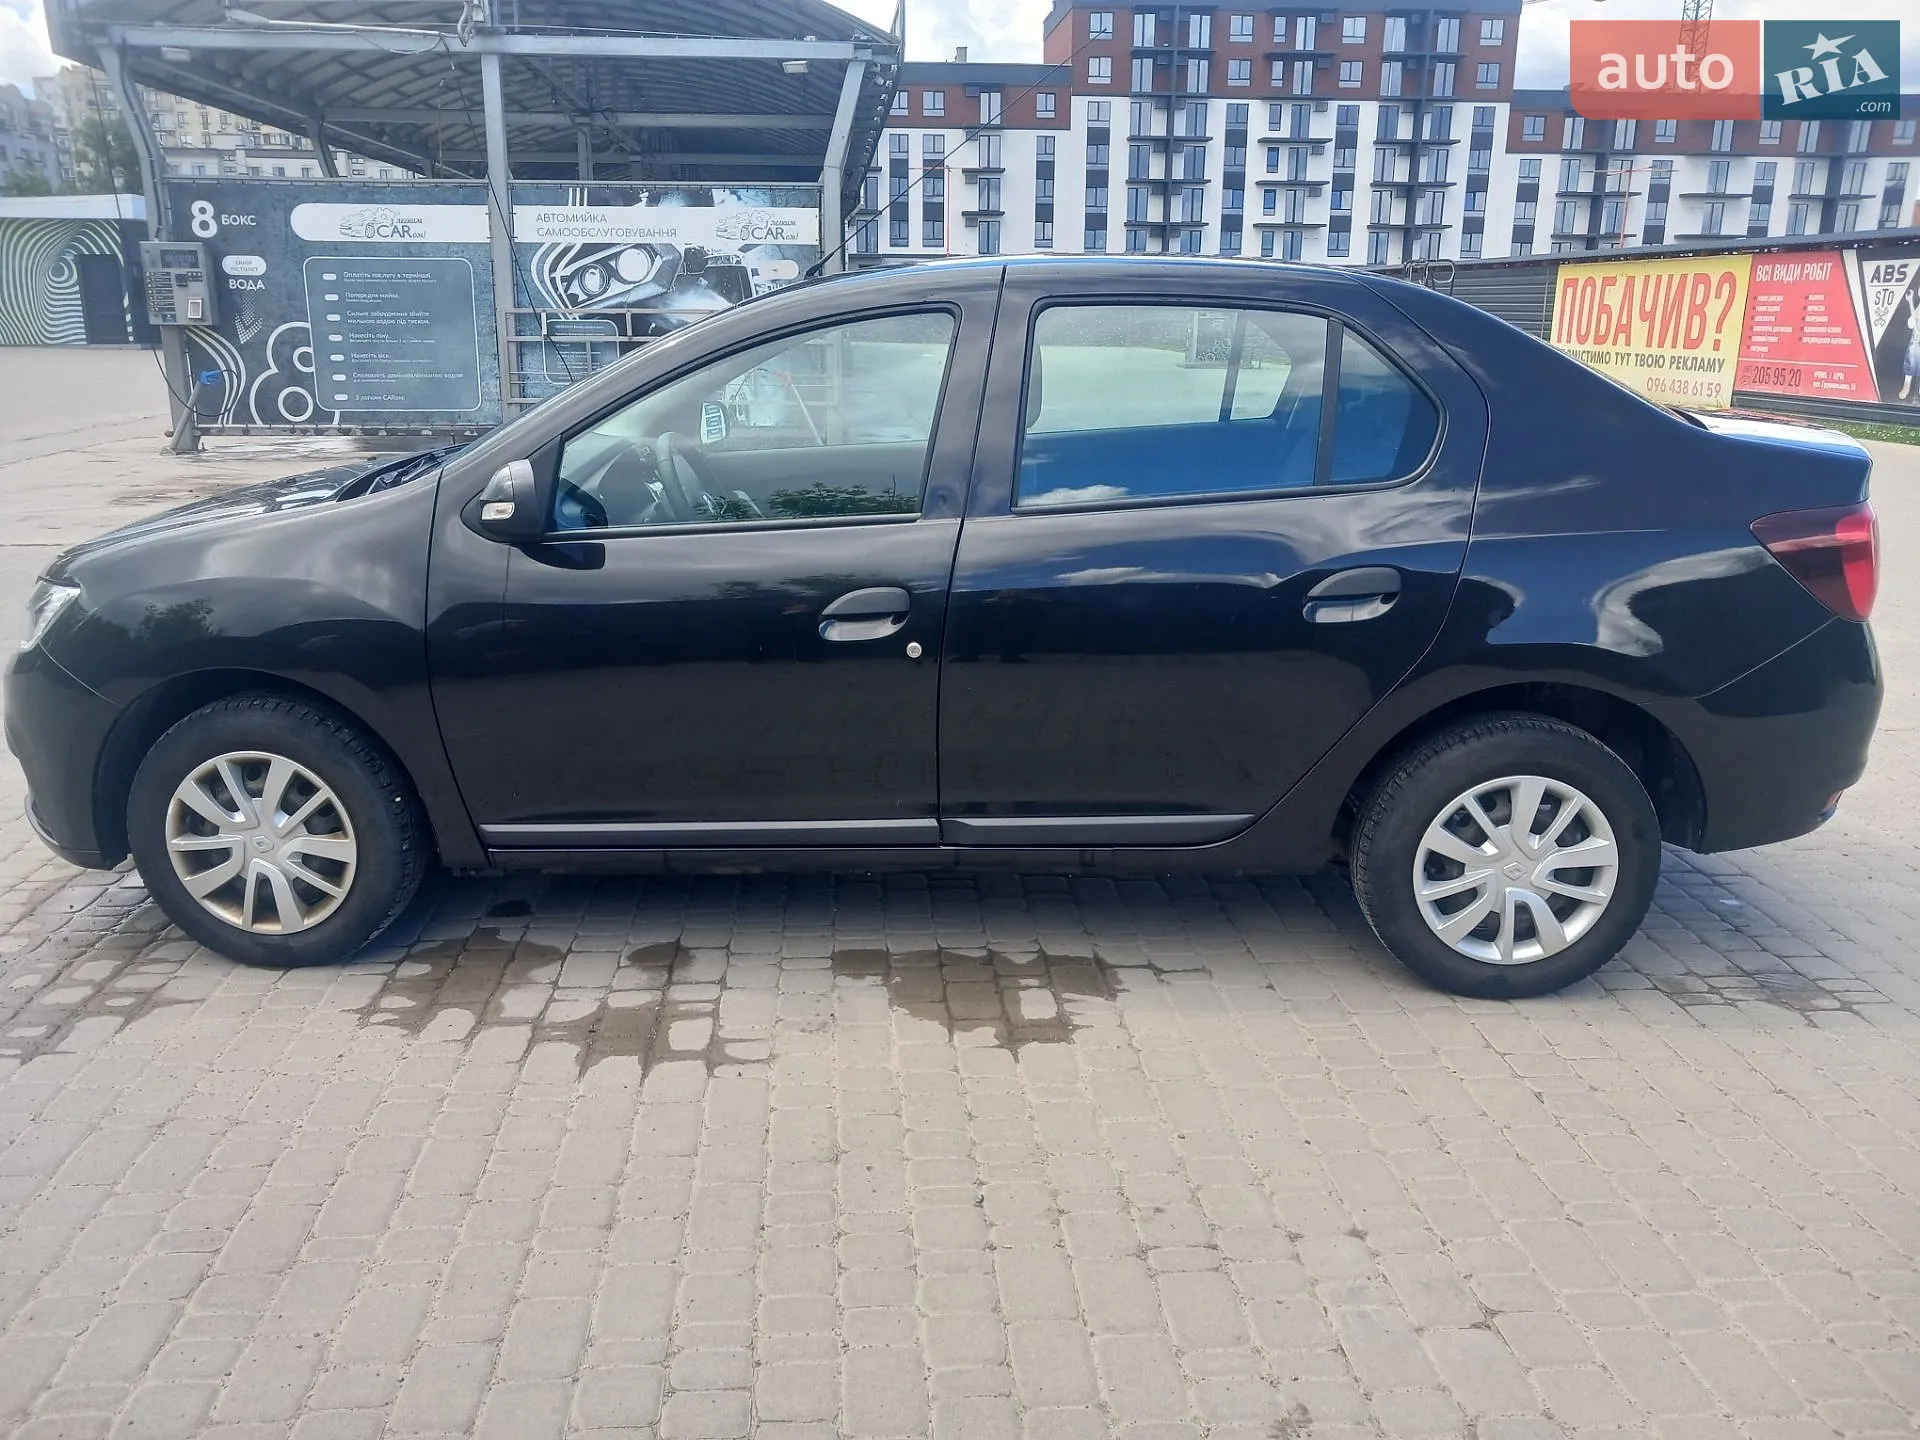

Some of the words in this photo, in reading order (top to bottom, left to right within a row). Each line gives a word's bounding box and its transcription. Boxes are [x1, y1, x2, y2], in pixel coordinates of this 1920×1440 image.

[191, 200, 218, 238] 8
[221, 214, 257, 226] БОКС
[535, 210, 608, 223] АВТОМИЙКА
[536, 227, 677, 238] САМООБСЛУГОВУВАННЯ
[1756, 265, 1772, 282] ВСІ
[1773, 264, 1801, 283] ВИДИ
[1802, 262, 1832, 281] РОБІТ
[1870, 263, 1909, 283] ABS
[228, 279, 265, 291] ВОДА
[1557, 271, 1737, 352] ПОБАЧИВ?
[1615, 352, 1631, 366] ТУТ
[1635, 353, 1666, 369] ТВОЮ
[1669, 354, 1726, 373] РЕКЛАМУ
[1646, 377, 1667, 393] 096
[1669, 379, 1688, 395] 438
[1752, 366, 1771, 385] 205
[1773, 367, 1786, 386] 95
[1788, 368, 1802, 387] 20
